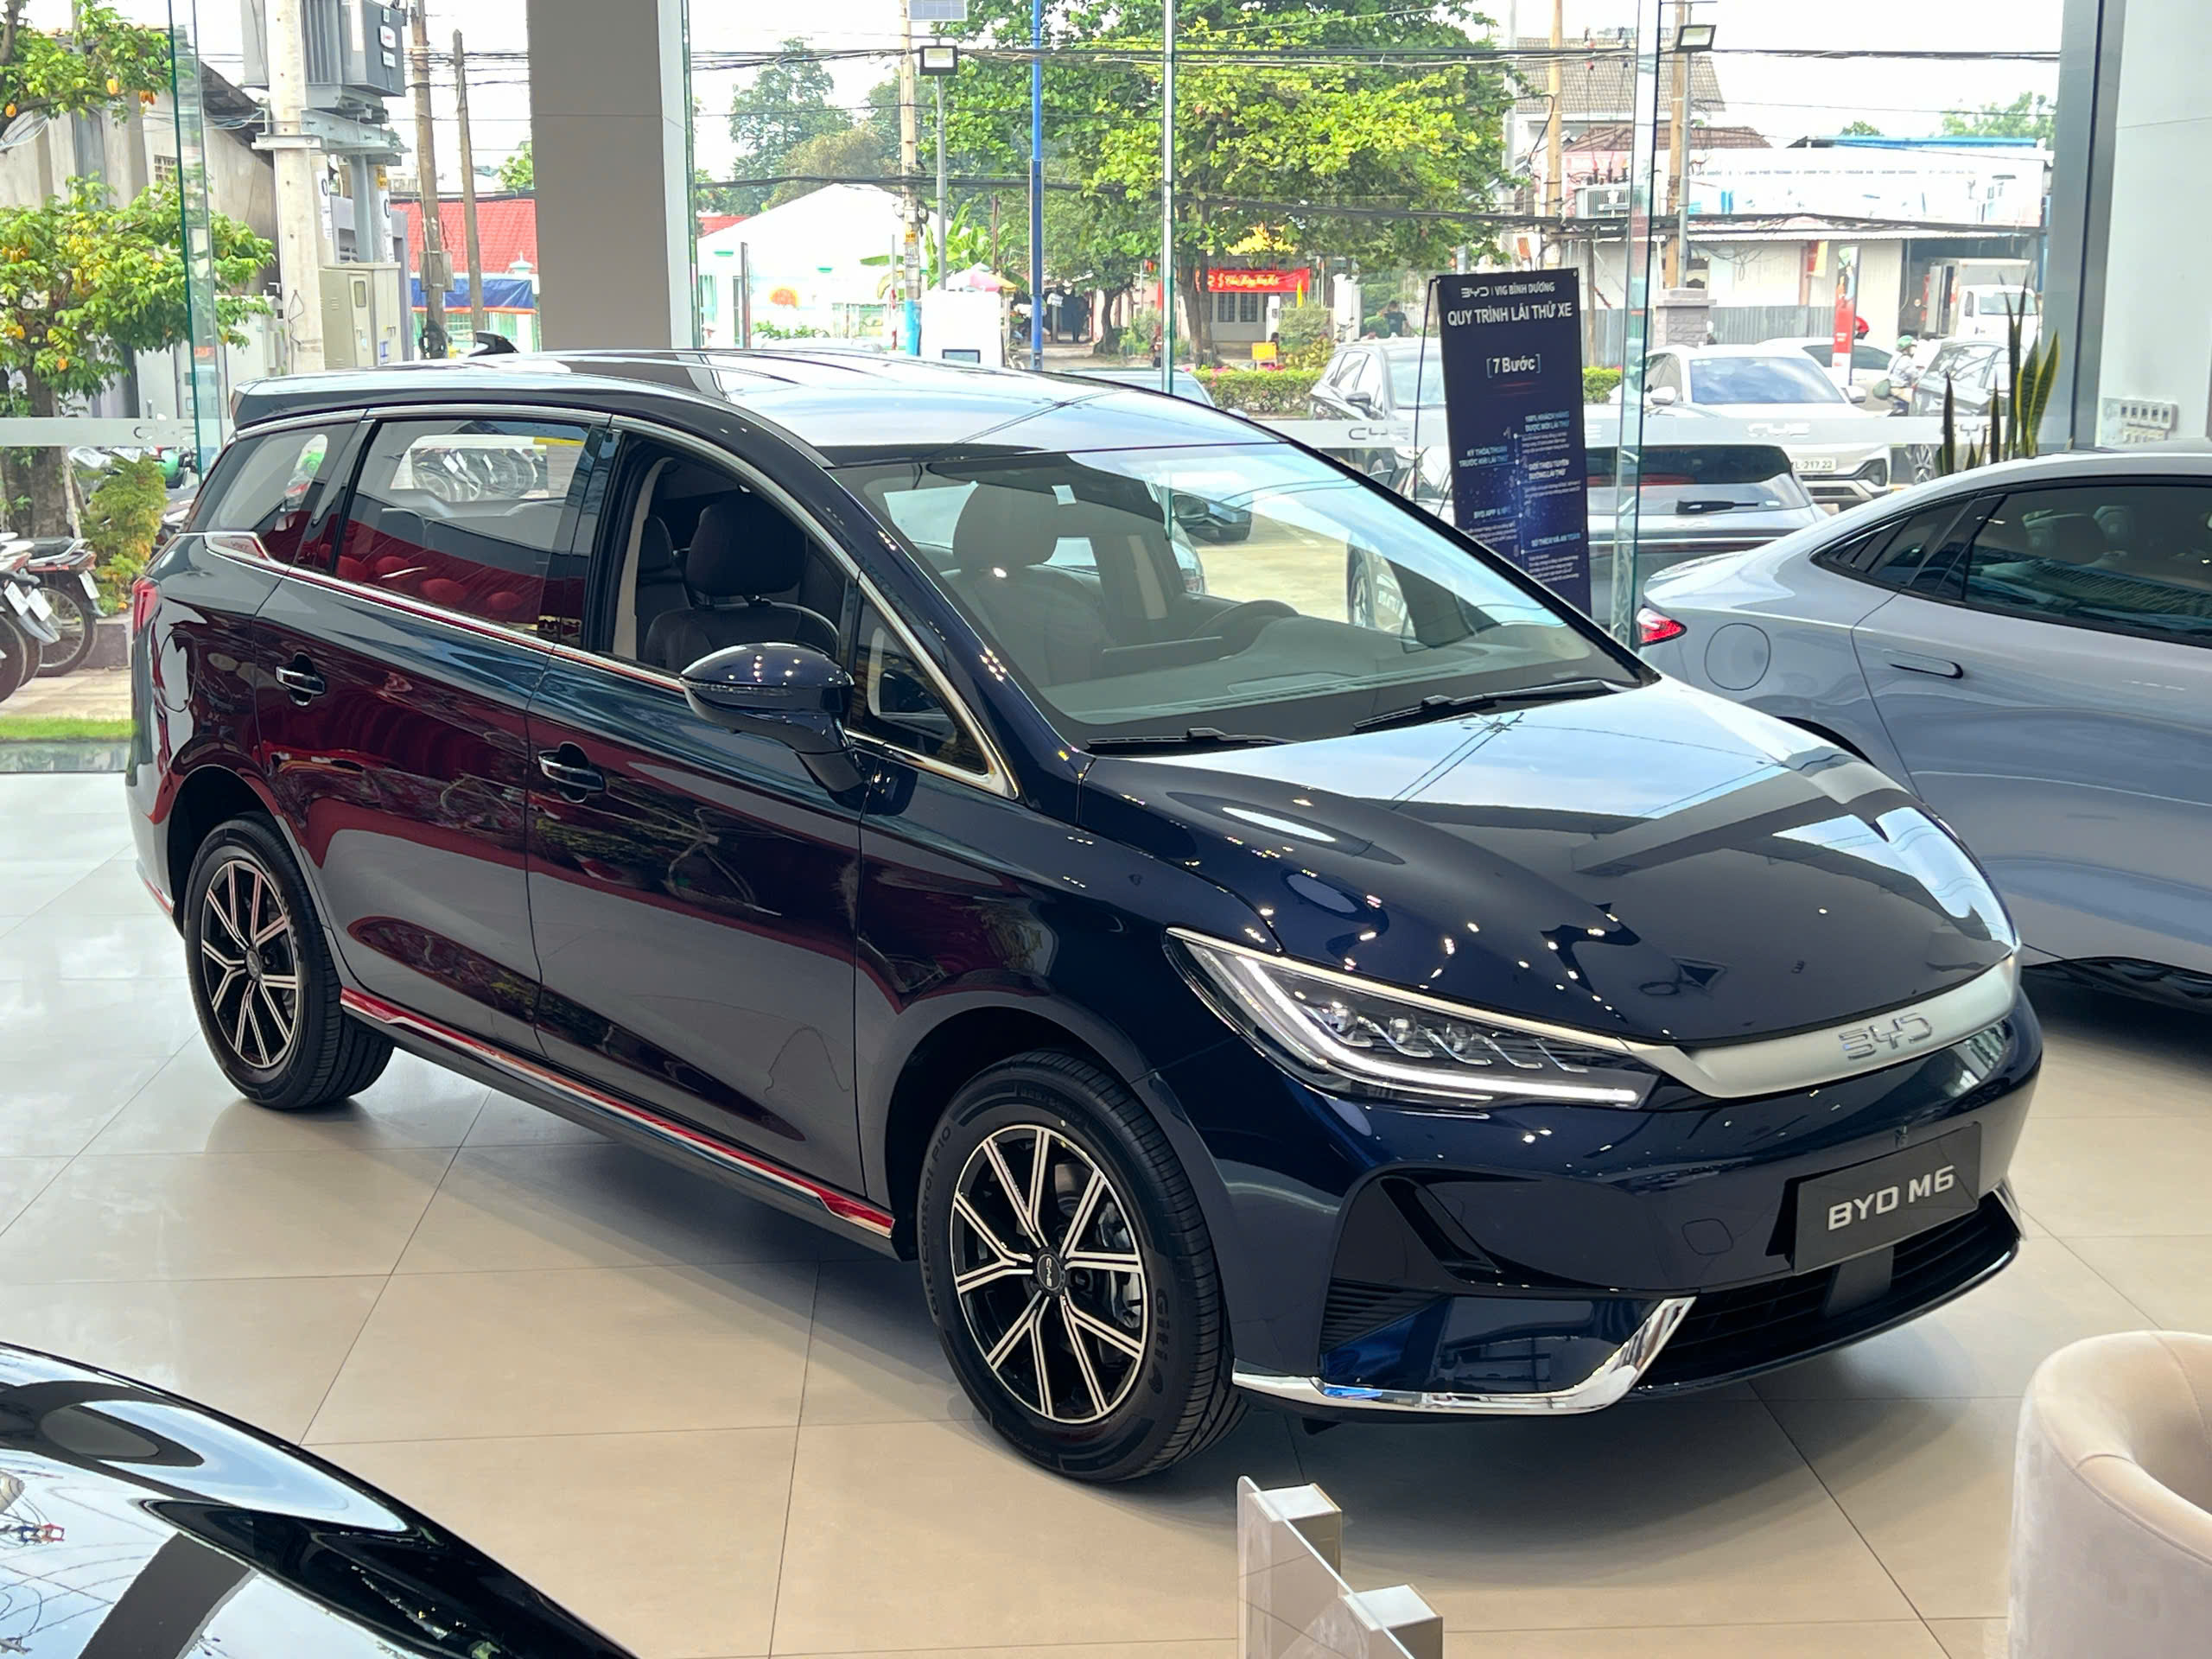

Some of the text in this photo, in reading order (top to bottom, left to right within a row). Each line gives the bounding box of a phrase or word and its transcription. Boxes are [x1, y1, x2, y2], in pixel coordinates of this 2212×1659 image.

[1447, 300, 1573, 327] QUY TRÌNH LÁI THỬ XE
[1838, 1012, 1933, 1060] BYD
[1827, 1164, 1955, 1231] BYD M6
